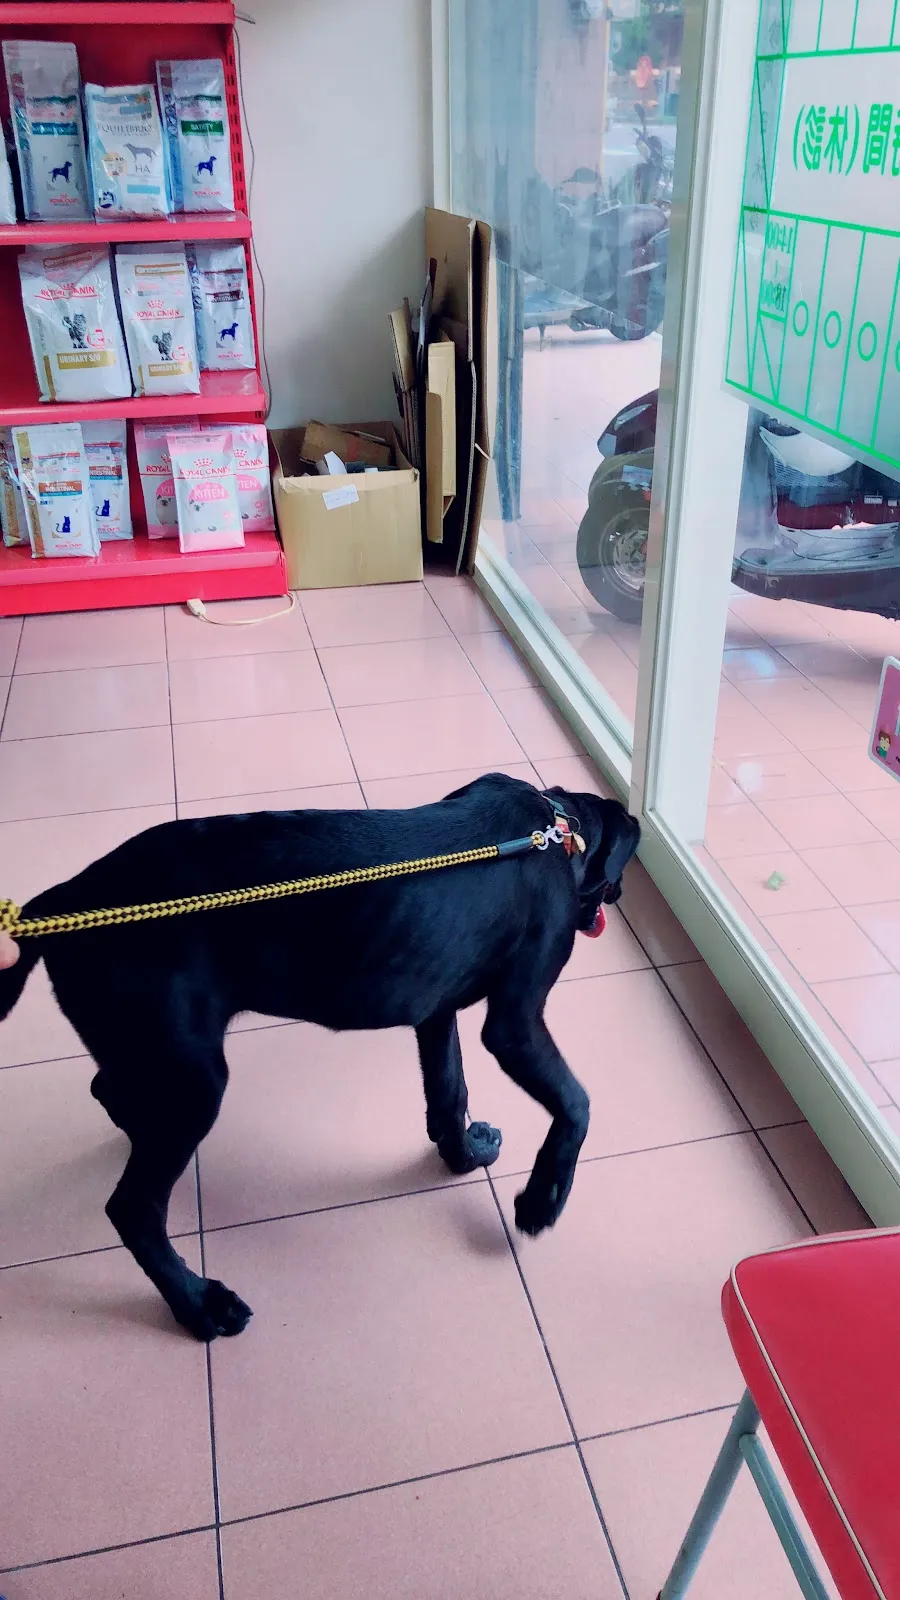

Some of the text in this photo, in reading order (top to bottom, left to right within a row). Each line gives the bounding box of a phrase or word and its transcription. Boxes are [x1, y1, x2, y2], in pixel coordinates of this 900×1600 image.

[135, 164, 151, 174] HA
[60, 354, 88, 364] URINARY
[239, 458, 263, 467] CANIN
[146, 465, 171, 473] ROYAL
[206, 465, 230, 475] CANIN
[194, 488, 225, 500] KITTEN
